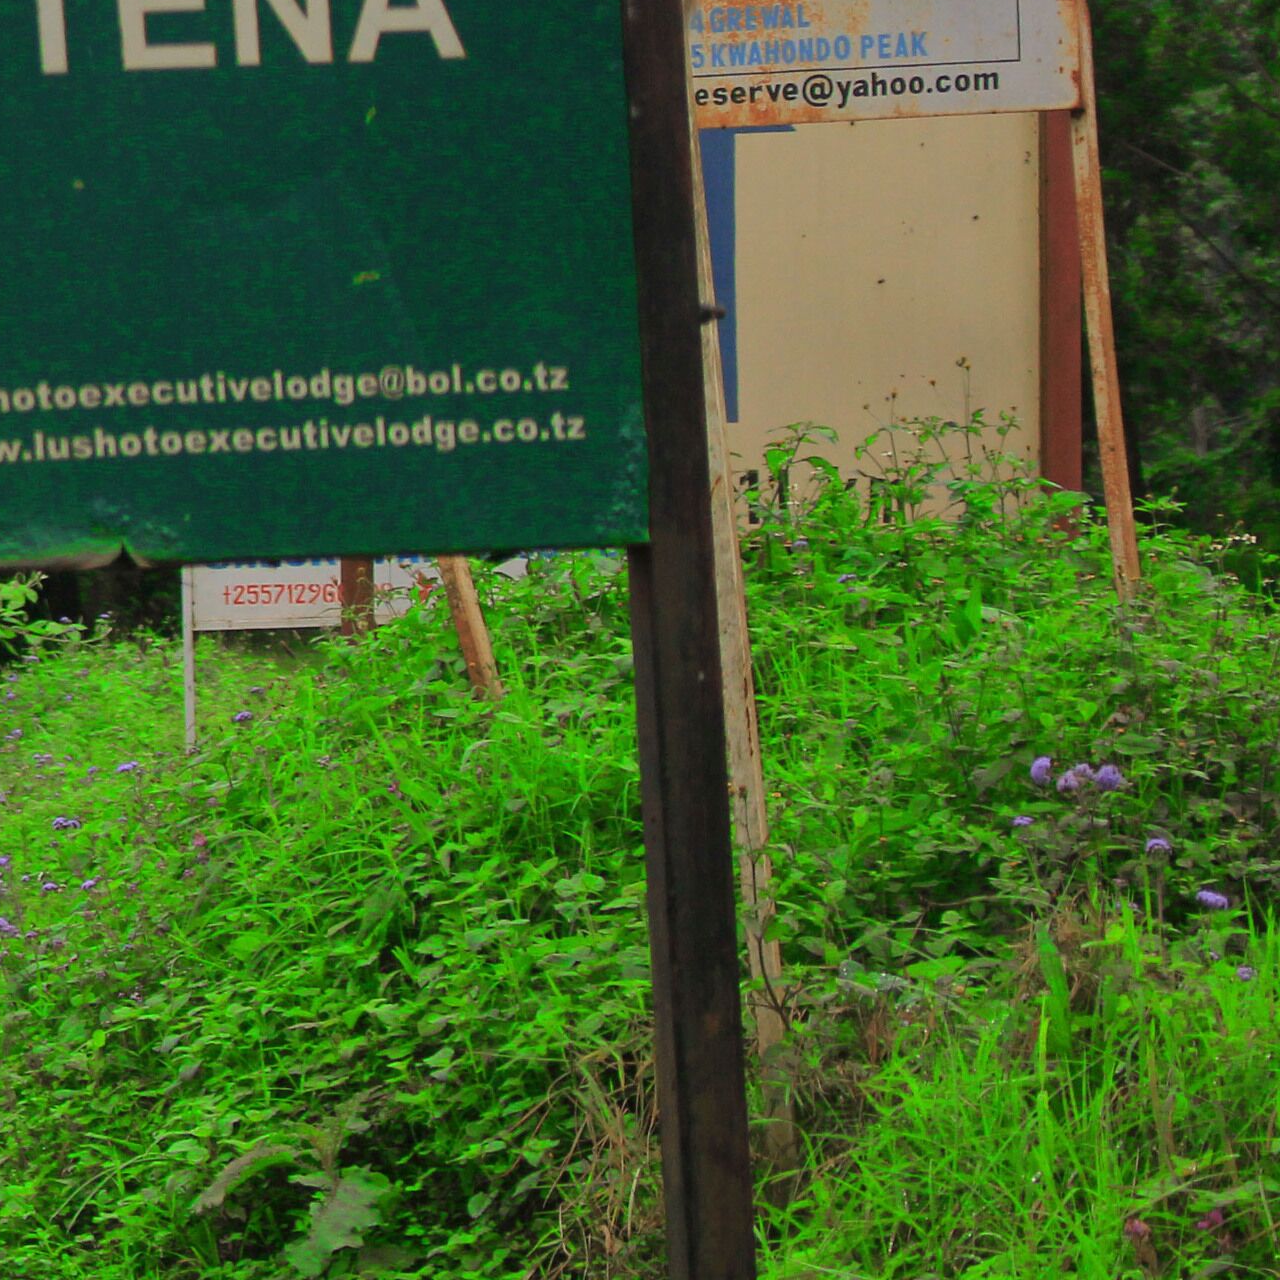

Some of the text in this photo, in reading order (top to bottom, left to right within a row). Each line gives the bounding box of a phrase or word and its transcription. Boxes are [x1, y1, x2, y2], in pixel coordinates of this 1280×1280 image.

[709, 3, 811, 33] GREWAL
[691, 32, 928, 69] 5 KWAHONDO PEAK
